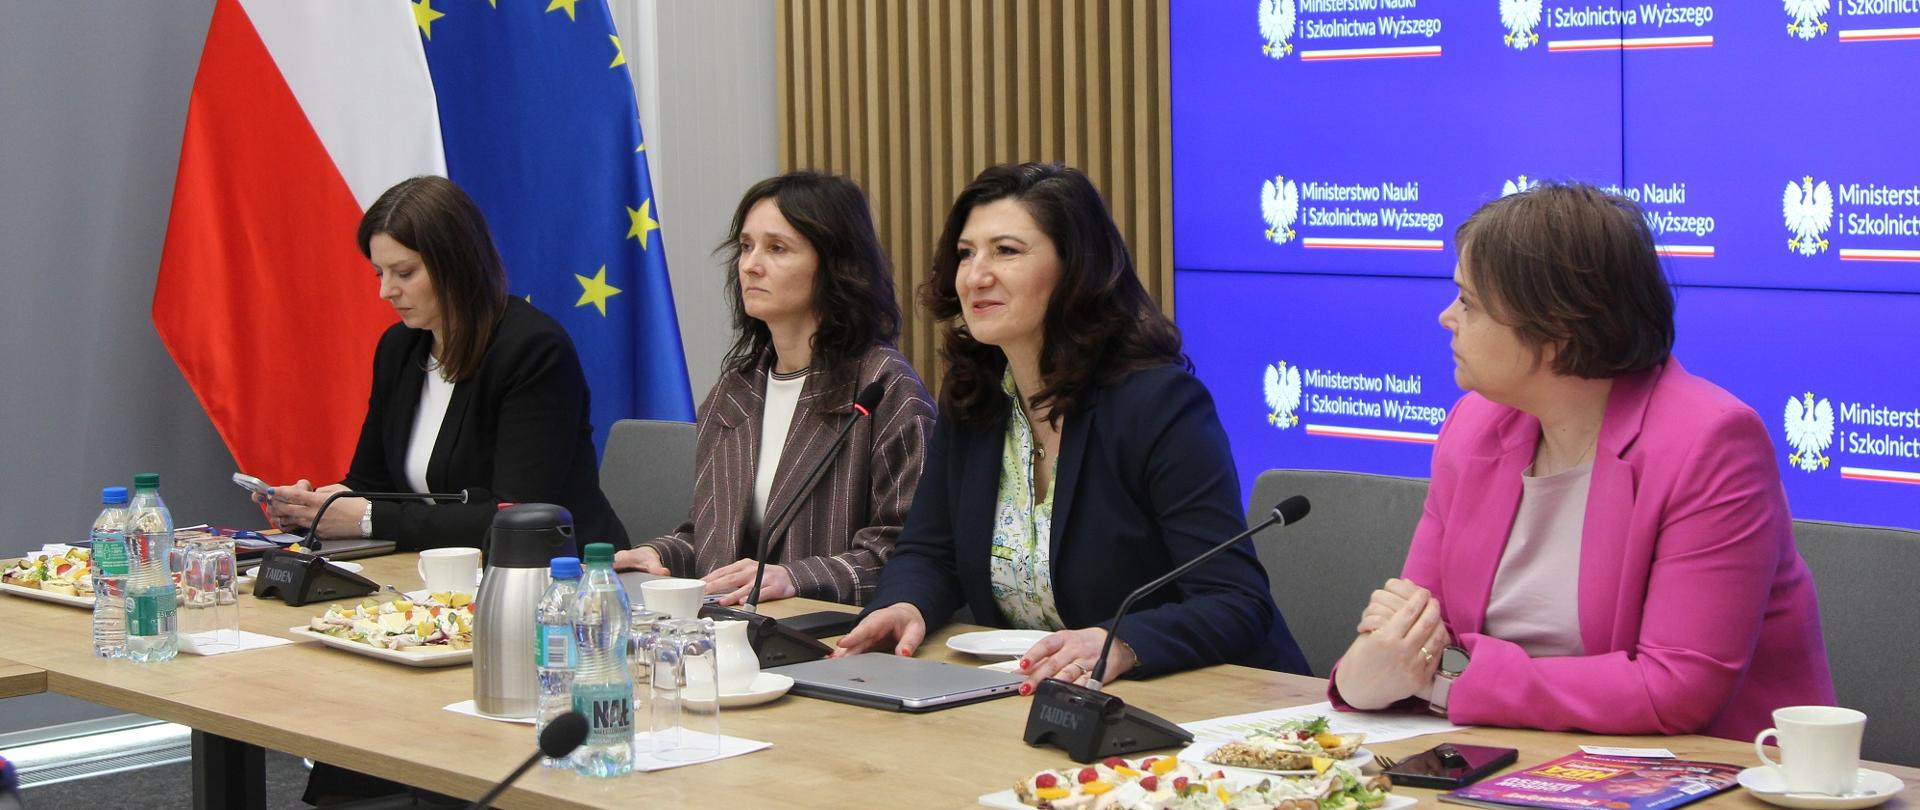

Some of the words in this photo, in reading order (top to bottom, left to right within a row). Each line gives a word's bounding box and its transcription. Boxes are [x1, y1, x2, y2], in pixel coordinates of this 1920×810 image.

[1547, 8, 1552, 27] i
[1555, 6, 1636, 27] Szkolnictwa
[1640, 3, 1713, 28] Wyższego
[1847, 0, 1920, 15] Szkolnict
[1299, 21, 1304, 38] i
[1307, 18, 1375, 38] Szkolnictwa
[1378, 16, 1441, 38] Wyższego
[1302, 182, 1380, 201] Ministerstwo
[1382, 182, 1418, 201] Nauki
[1644, 183, 1685, 204] Nauki
[1302, 207, 1307, 225] i
[1309, 207, 1378, 226] Szkolnictwa
[1381, 208, 1443, 231] Wyższego
[1838, 213, 1844, 234] i
[1848, 213, 1920, 235] Szkolnict
[1305, 369, 1382, 391] Ministerstwo
[1386, 374, 1420, 393] Nauki
[1305, 394, 1310, 411] i
[1312, 394, 1380, 417] Szkolnictwa
[1384, 400, 1446, 425] Wyższego
[1840, 431, 1845, 451] i
[266, 567, 294, 584] TAIDEN
[1040, 704, 1078, 730] TAIDEN
